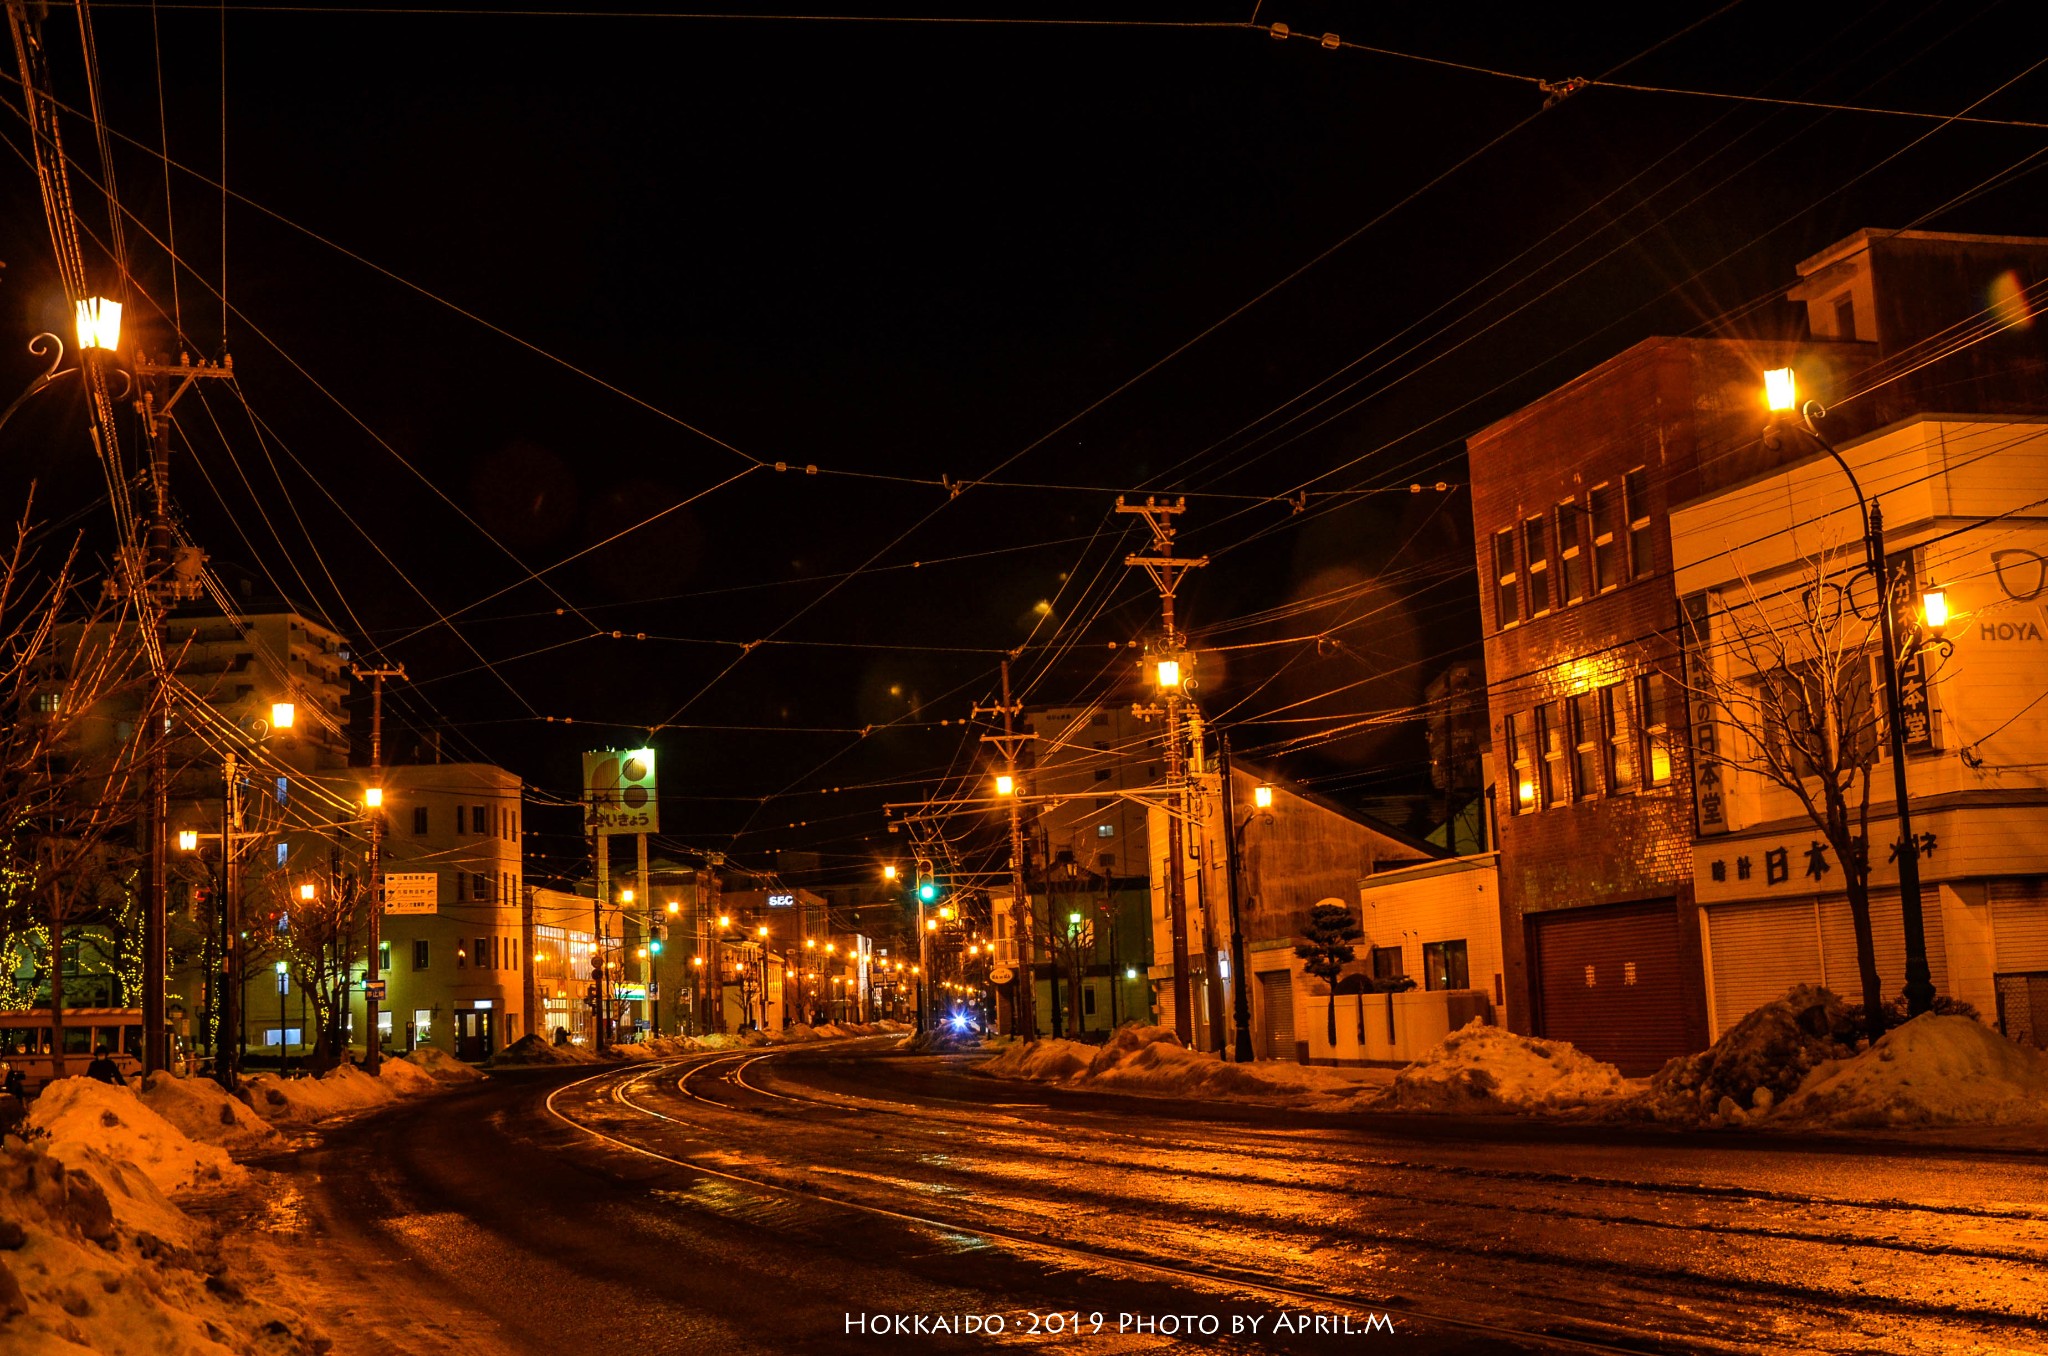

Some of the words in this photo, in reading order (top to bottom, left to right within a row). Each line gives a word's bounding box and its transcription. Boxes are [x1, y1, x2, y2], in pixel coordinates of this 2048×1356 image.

[1981, 622, 2043, 641] HOYA
[1888, 832, 1938, 864] メネ
[769, 895, 794, 906] SEC
